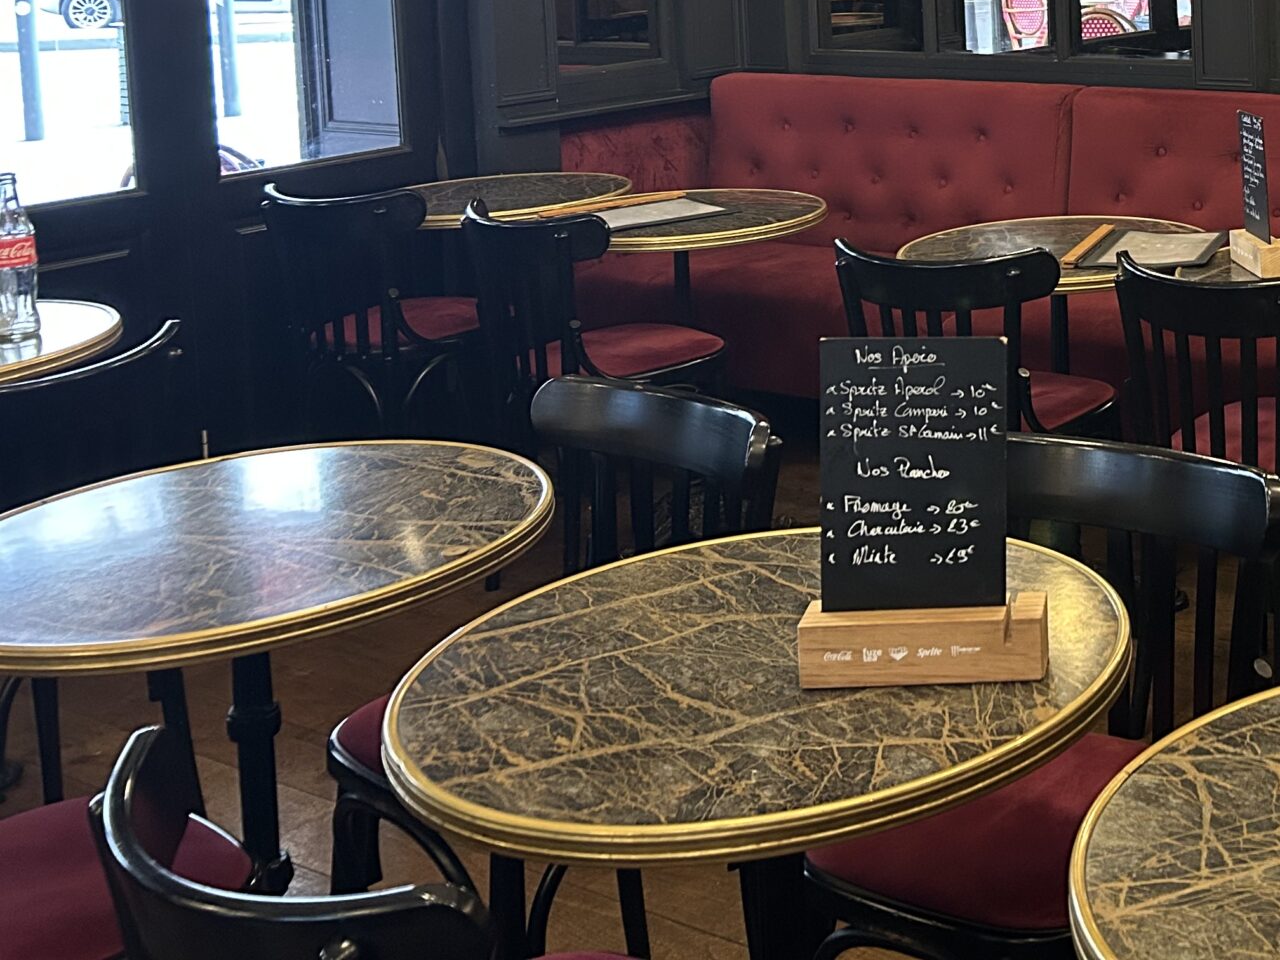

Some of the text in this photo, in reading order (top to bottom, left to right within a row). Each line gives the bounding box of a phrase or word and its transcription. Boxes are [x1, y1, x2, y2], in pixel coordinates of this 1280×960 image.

[855, 345, 882, 365] Nos
[895, 376, 945, 400] Aperol
[842, 400, 888, 422] Spritz
[894, 402, 948, 423] Campari
[840, 419, 892, 442] Spritz
[857, 458, 890, 478] Nos
[844, 495, 911, 519] Fromage
[847, 519, 926, 538] Charcuterie
[916, 647, 943, 658] Sprite
